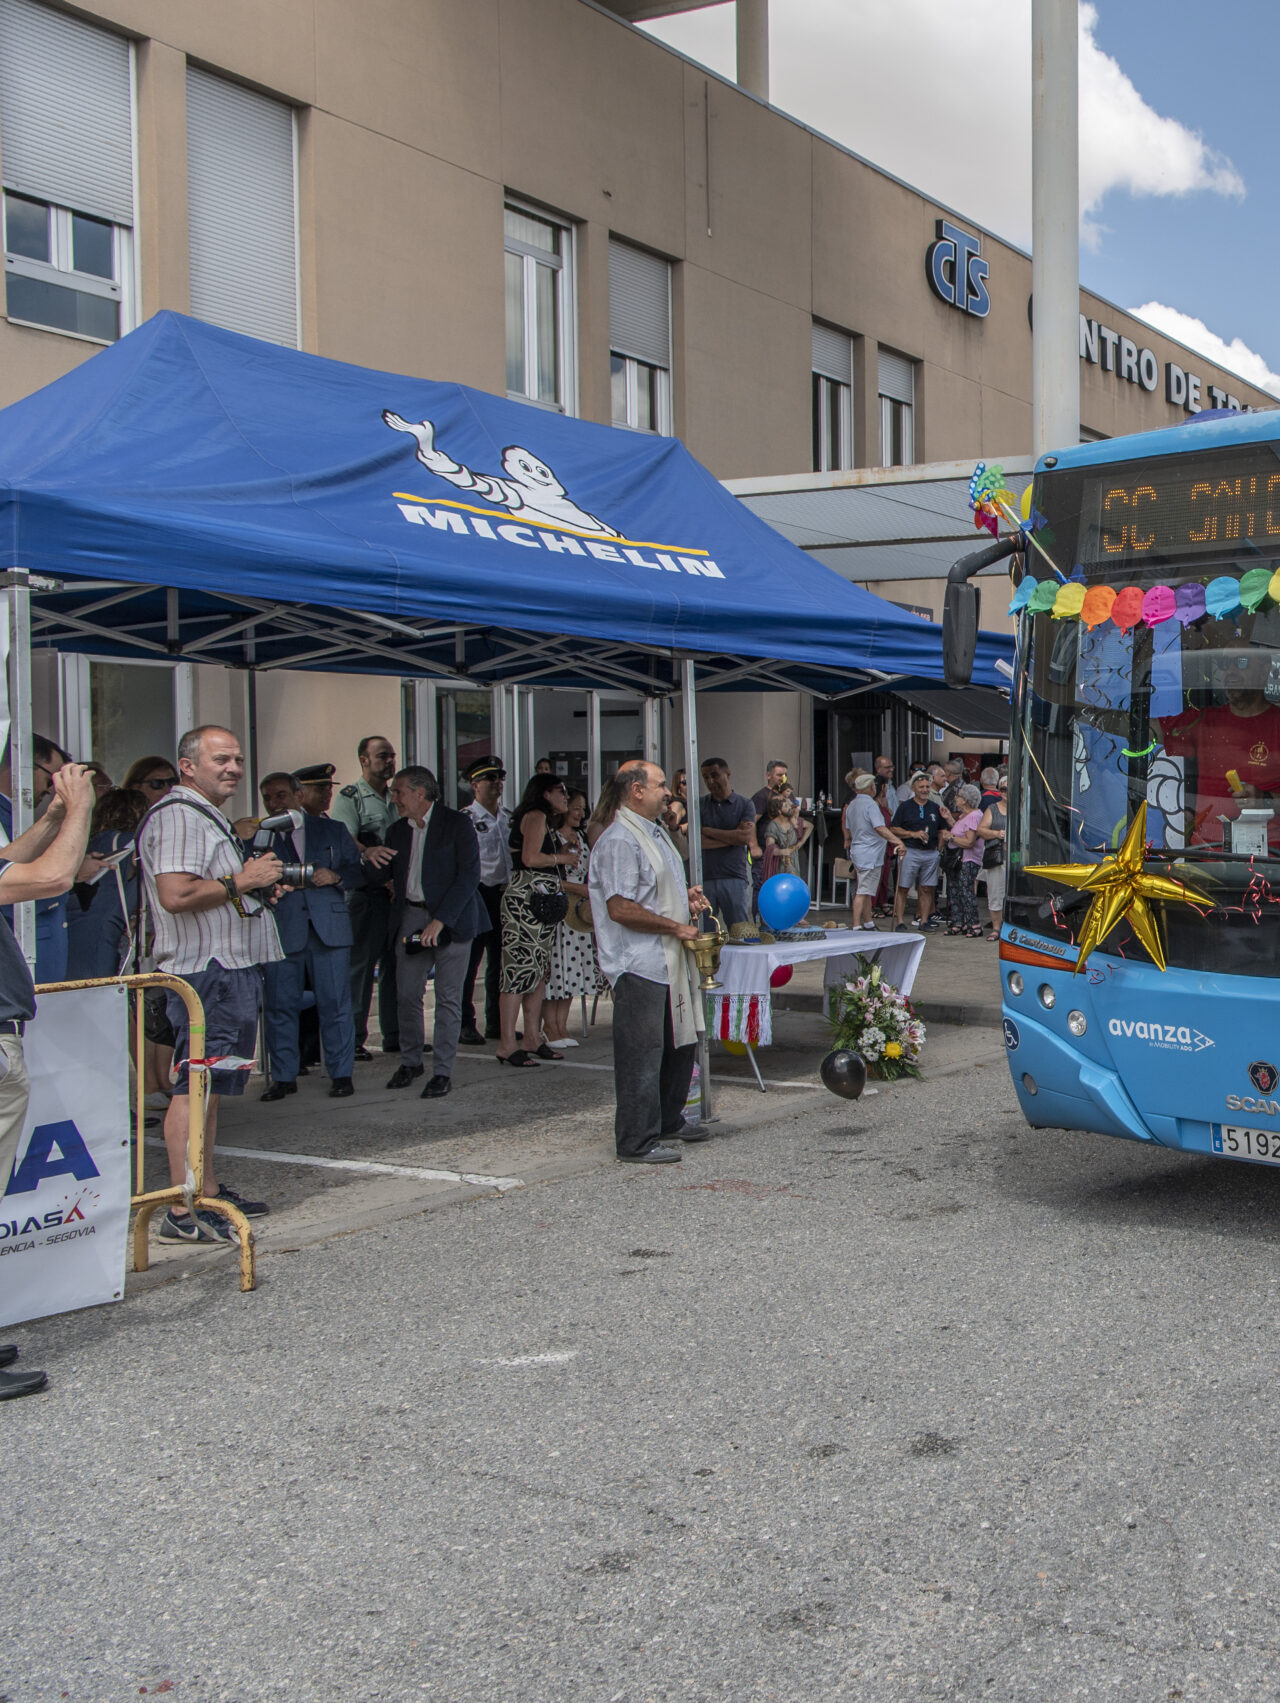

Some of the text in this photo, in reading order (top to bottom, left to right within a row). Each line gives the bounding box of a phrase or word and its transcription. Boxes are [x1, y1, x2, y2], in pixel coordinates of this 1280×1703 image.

[1165, 362, 1201, 414] DE
[397, 504, 726, 579] MICHELIN
[1108, 1018, 1192, 1044] avanza
[3, 1119, 101, 1197] A
[45, 1225, 96, 1246] SEGOVIA
